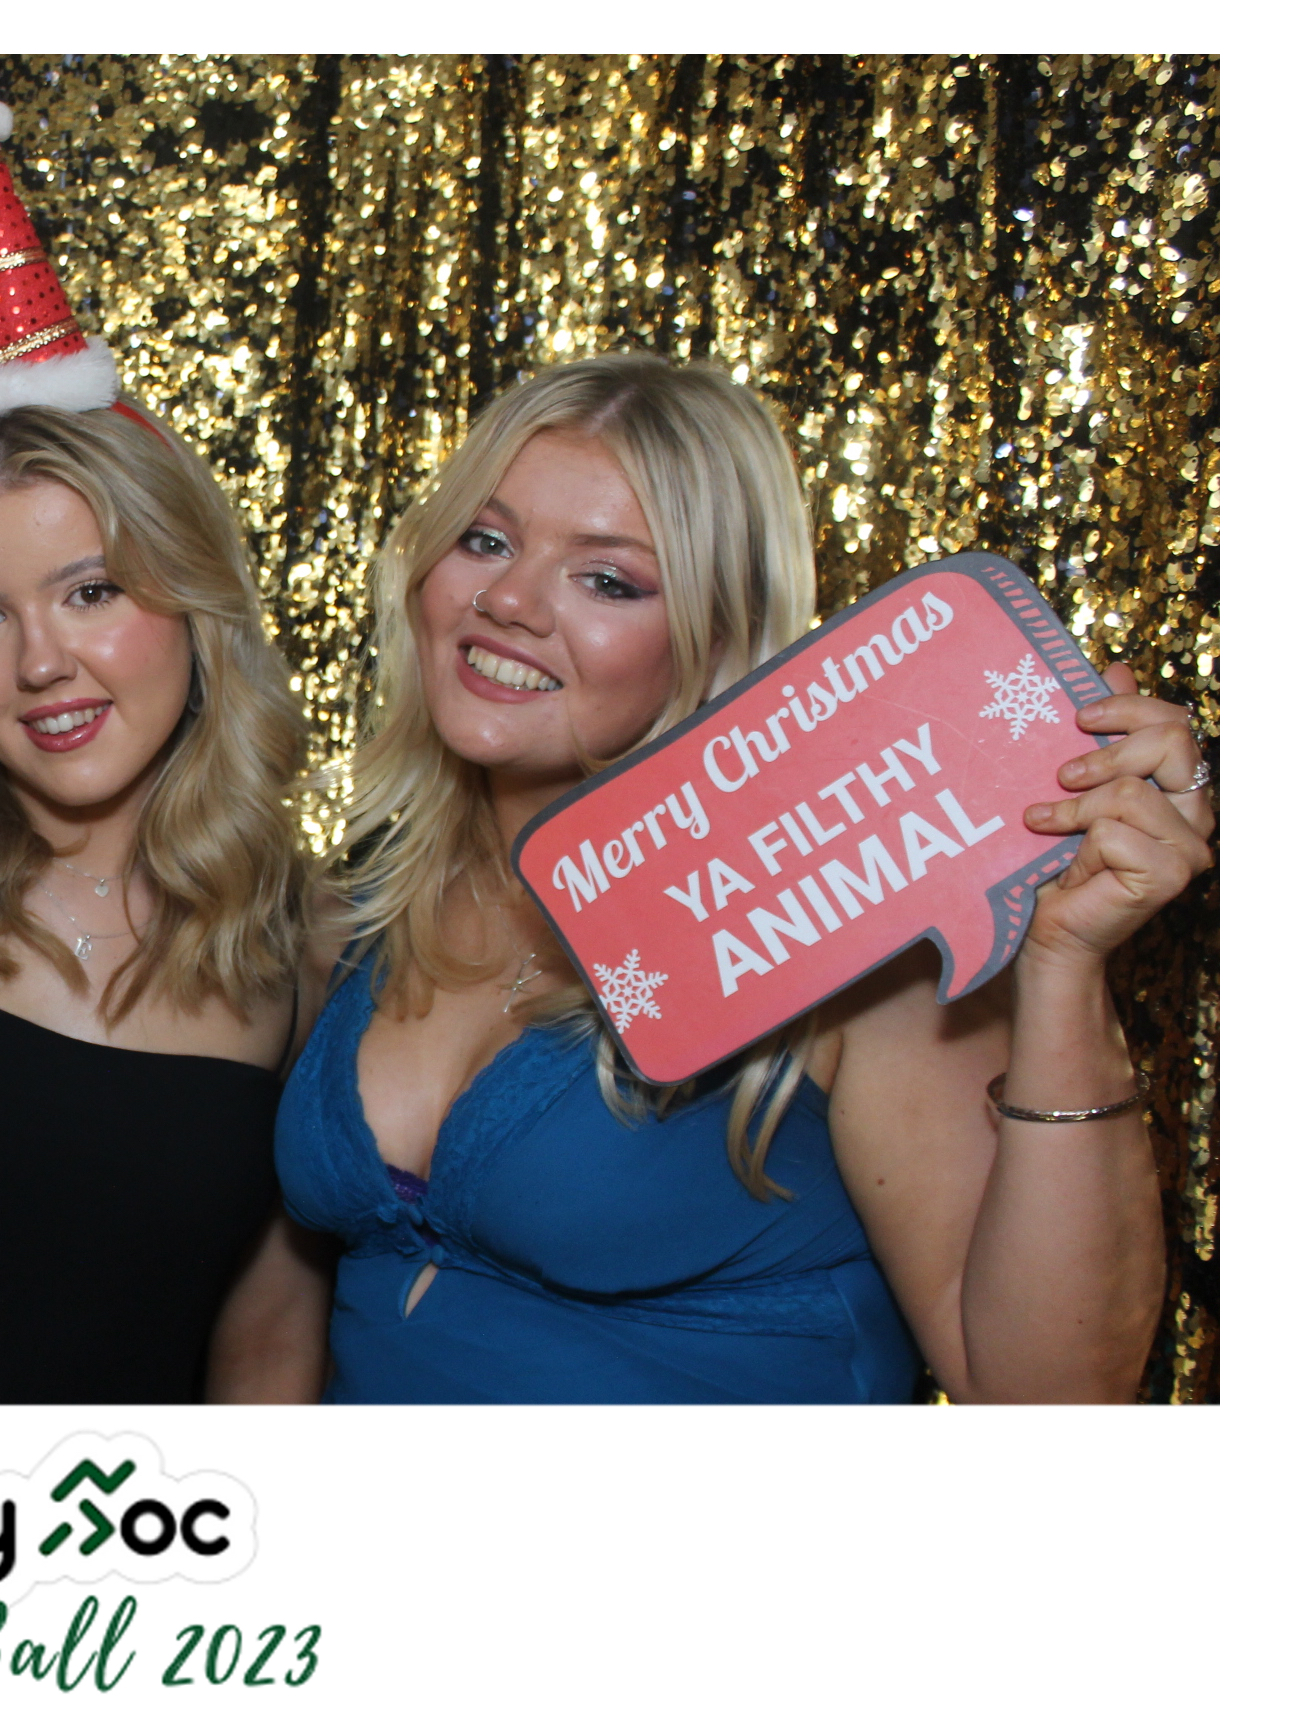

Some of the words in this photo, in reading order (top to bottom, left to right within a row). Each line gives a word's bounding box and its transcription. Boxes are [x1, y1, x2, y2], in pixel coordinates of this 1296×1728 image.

[552, 781, 711, 913] Merry
[704, 592, 954, 792] Christmas
[664, 857, 755, 922] YA
[748, 723, 943, 876] FILTHY
[706, 788, 1006, 998] ANIMAL
